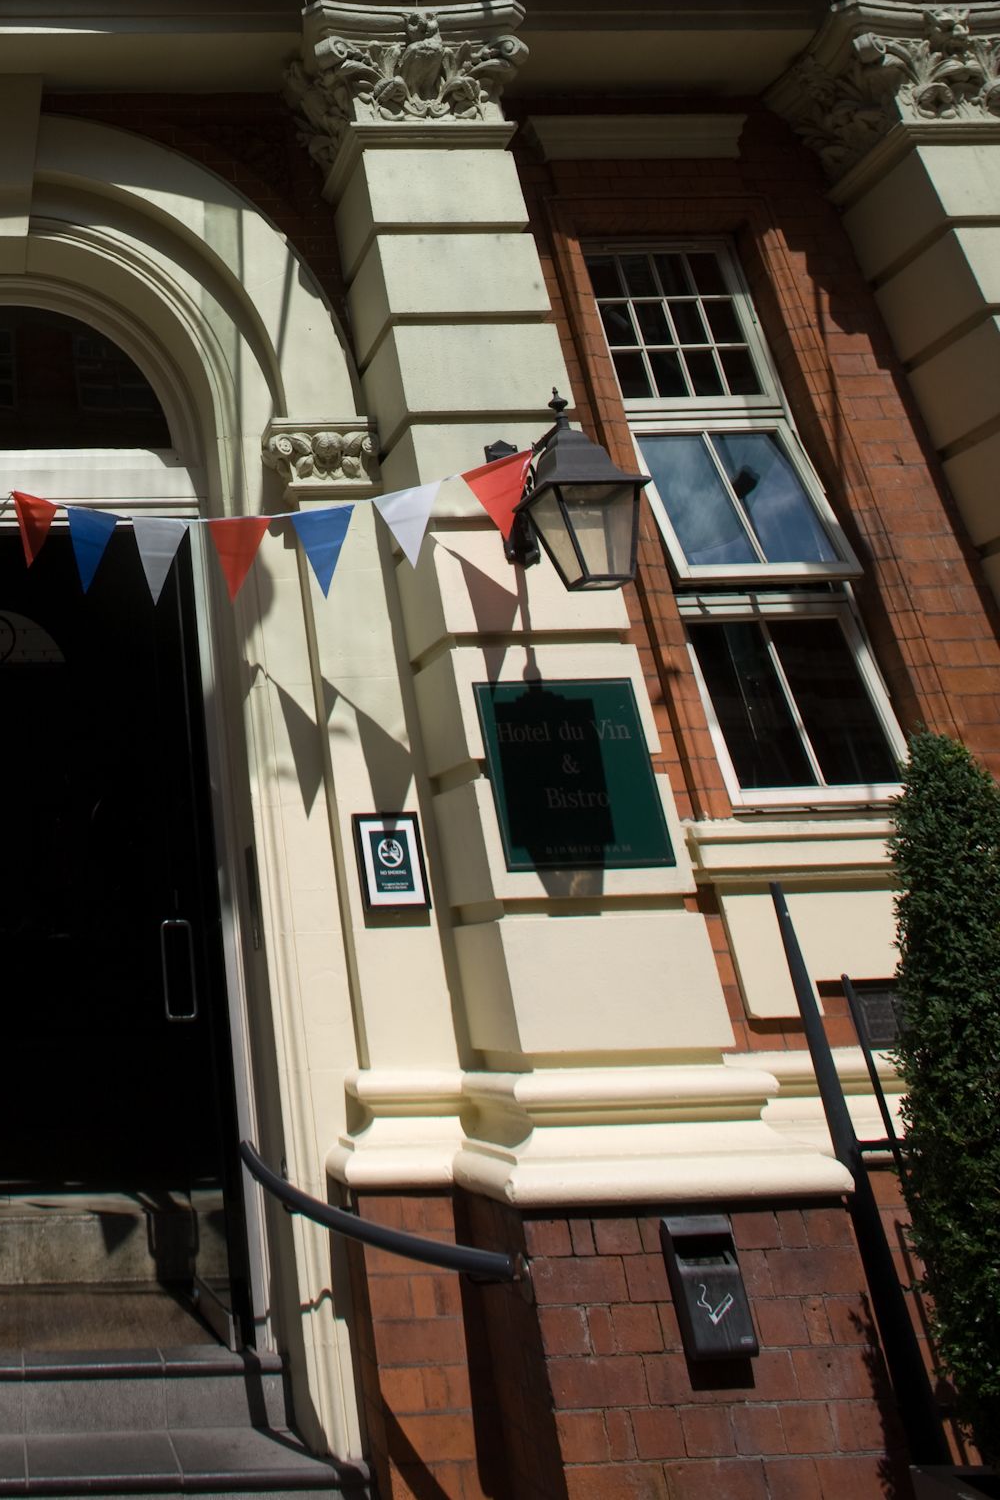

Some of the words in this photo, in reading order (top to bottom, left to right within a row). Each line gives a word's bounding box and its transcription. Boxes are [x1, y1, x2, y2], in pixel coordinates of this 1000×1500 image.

[496, 721, 552, 742] Hotel
[558, 719, 585, 741] du
[590, 719, 632, 740] Vin
[561, 753, 581, 774] &
[544, 787, 611, 809] Bistro
[546, 843, 632, 854] BIRMINGHAM
